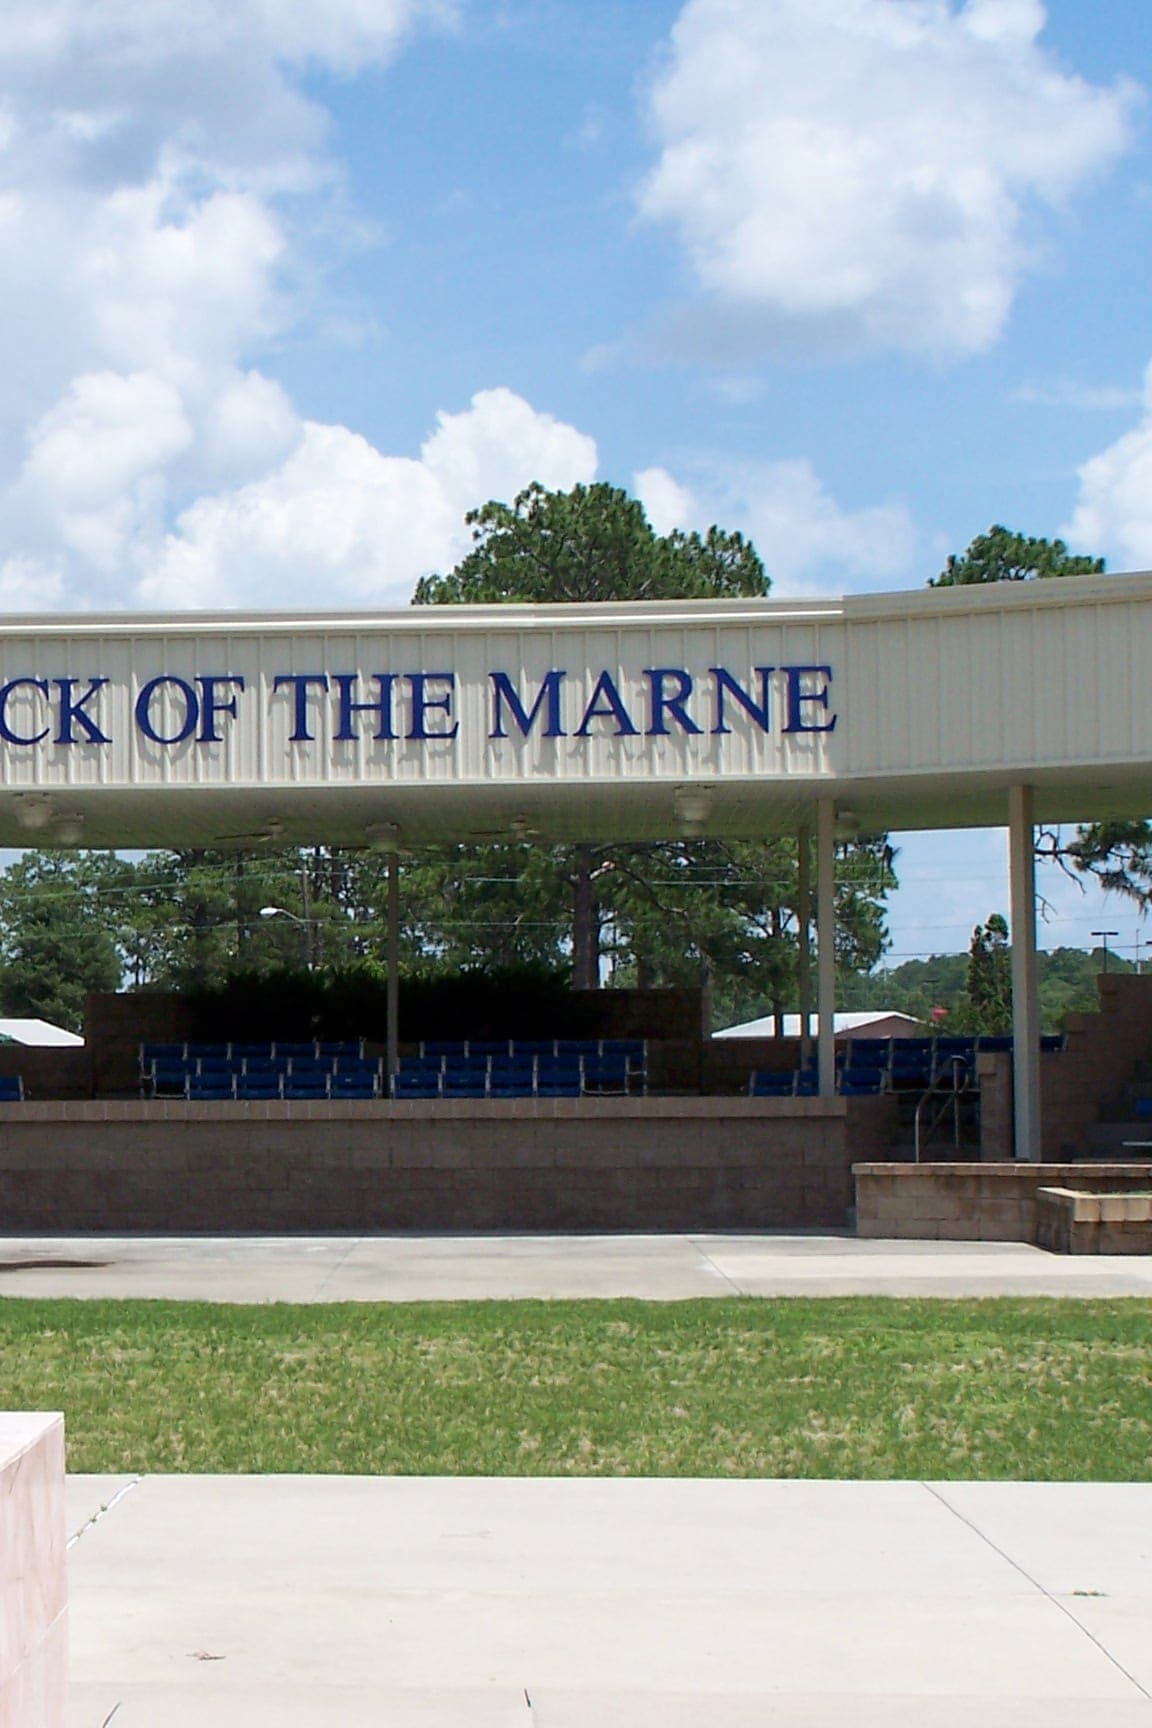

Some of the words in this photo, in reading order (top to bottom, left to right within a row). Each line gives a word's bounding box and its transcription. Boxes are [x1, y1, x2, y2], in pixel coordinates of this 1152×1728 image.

[135, 674, 245, 745] OF
[273, 670, 459, 741] THE
[487, 664, 838, 739] MARNE
